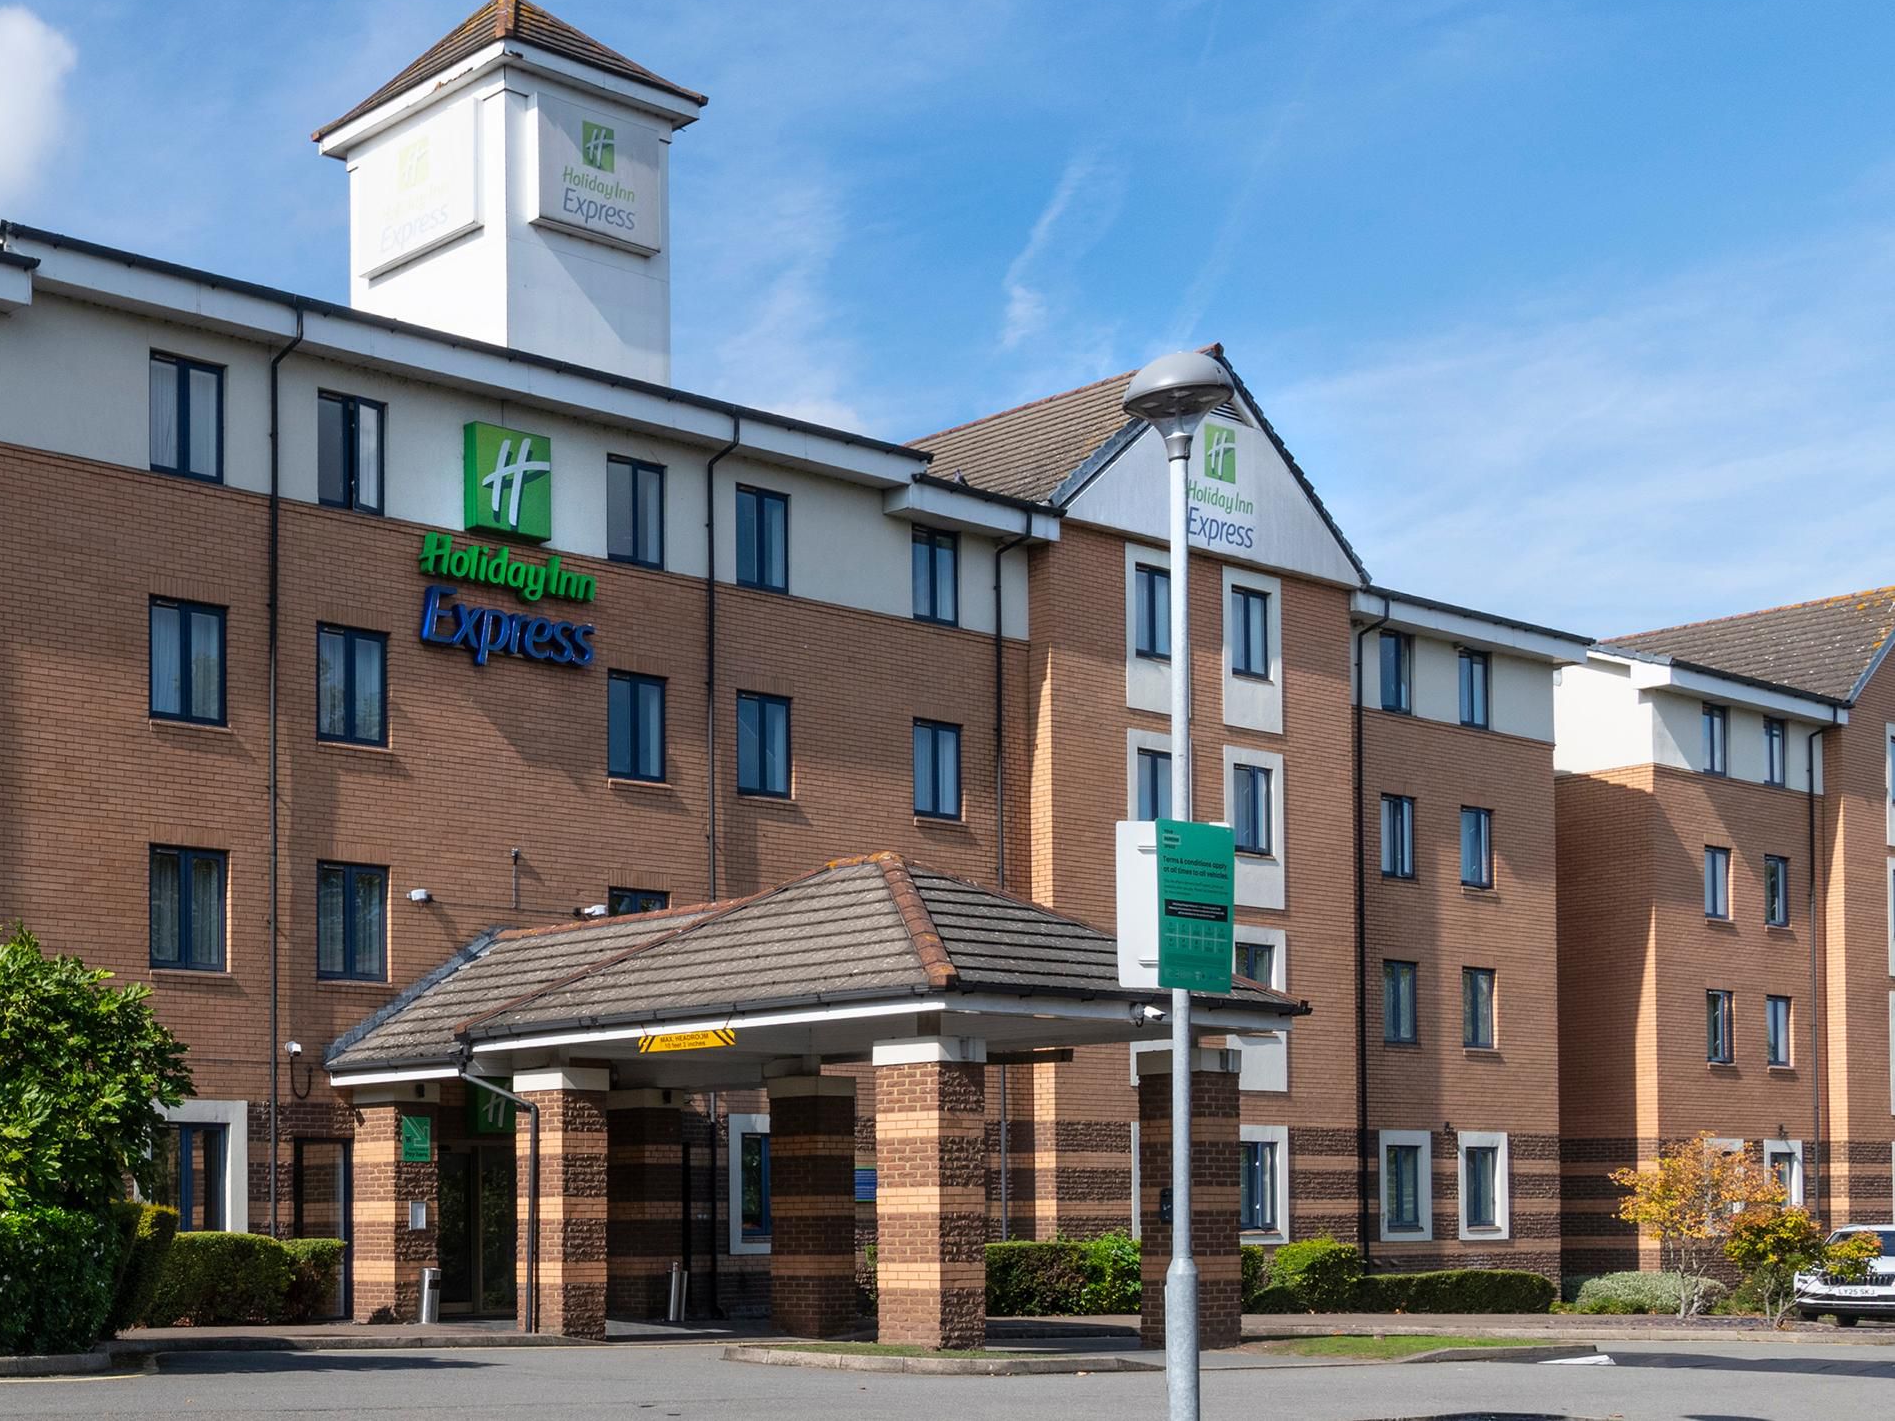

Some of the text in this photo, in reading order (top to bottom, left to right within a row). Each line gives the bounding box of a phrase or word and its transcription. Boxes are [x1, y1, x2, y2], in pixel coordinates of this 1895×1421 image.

[562, 165, 635, 203] Holiday Inn
[379, 203, 449, 254] Express
[562, 186, 636, 230] Express
[1187, 479, 1254, 515] Holiday Inn
[1187, 506, 1255, 549] Express
[419, 531, 597, 603] Holiday Inn
[419, 584, 597, 667] Express
[675, 1033, 709, 1042] HEADROOM
